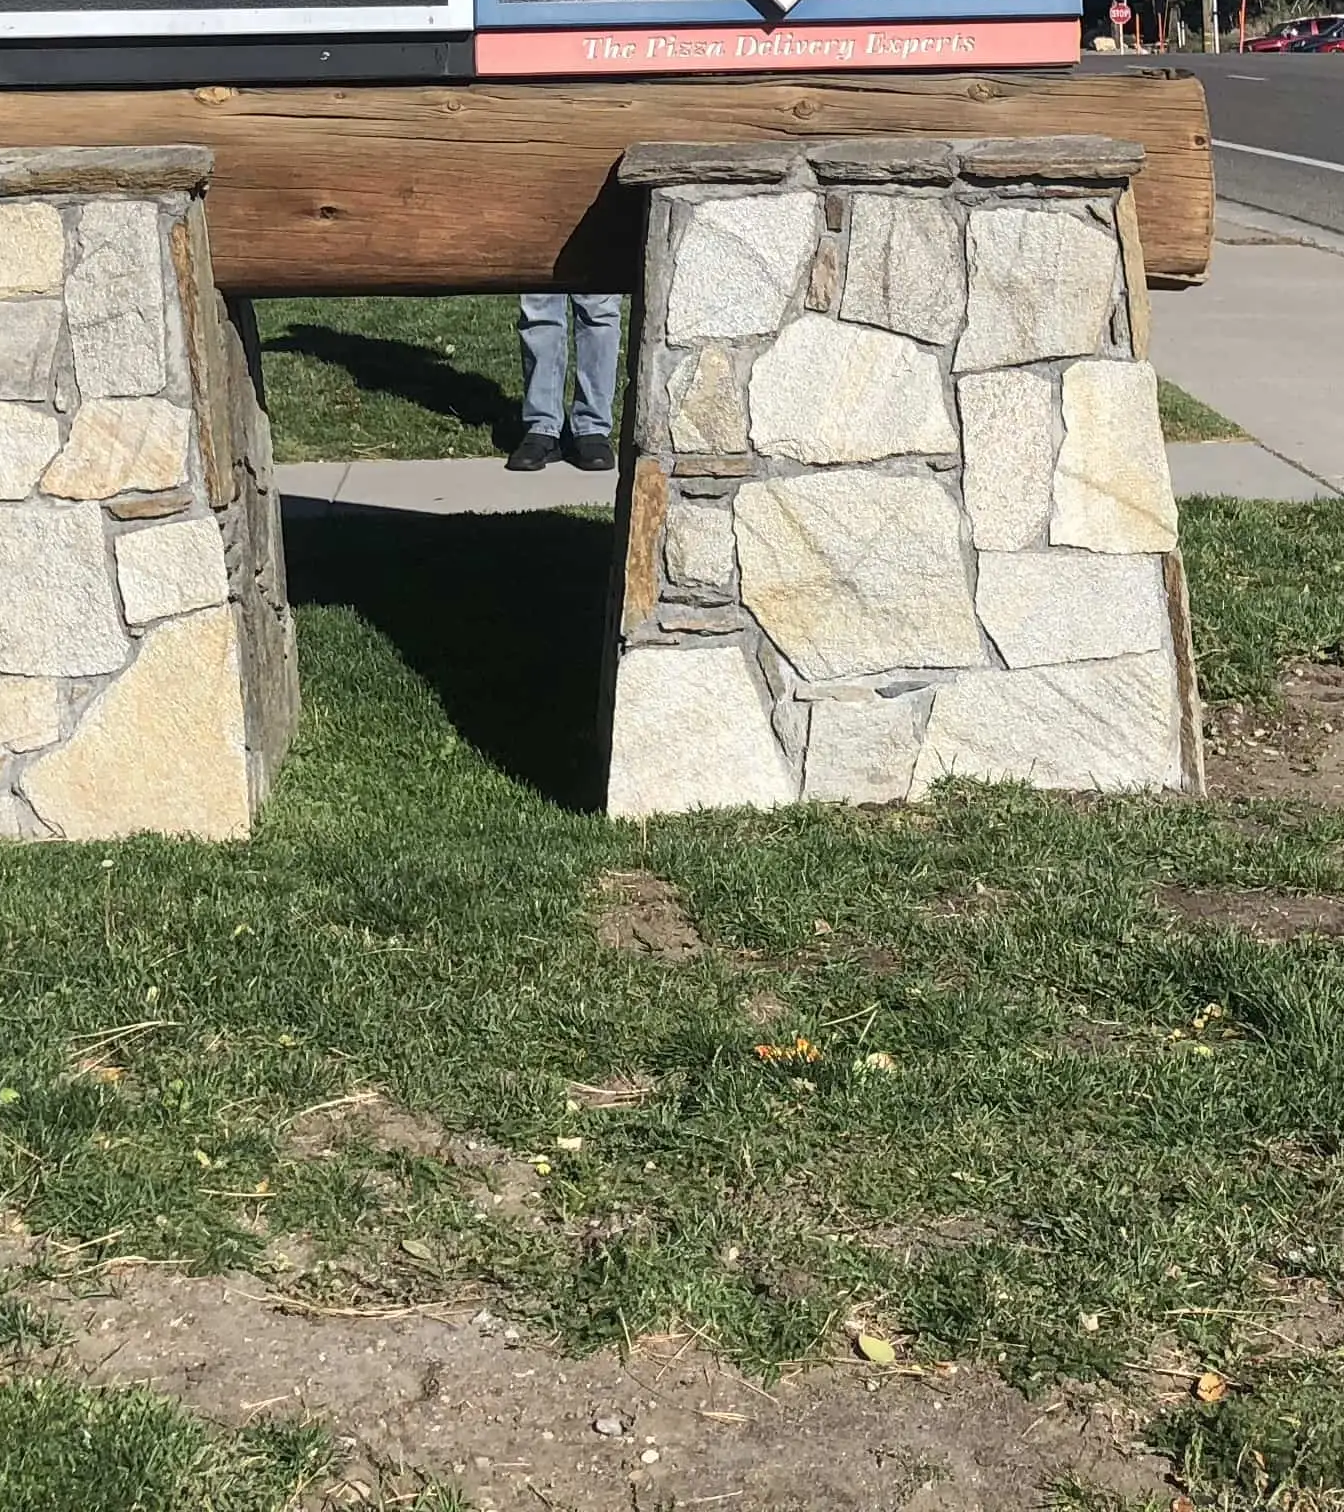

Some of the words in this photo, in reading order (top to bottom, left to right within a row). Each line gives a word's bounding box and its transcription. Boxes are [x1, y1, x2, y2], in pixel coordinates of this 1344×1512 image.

[1111, 9, 1129, 18] STOP
[582, 36, 636, 60] The
[645, 35, 725, 59] Pizza
[735, 32, 855, 61] Delivery
[865, 32, 977, 59] Experts
